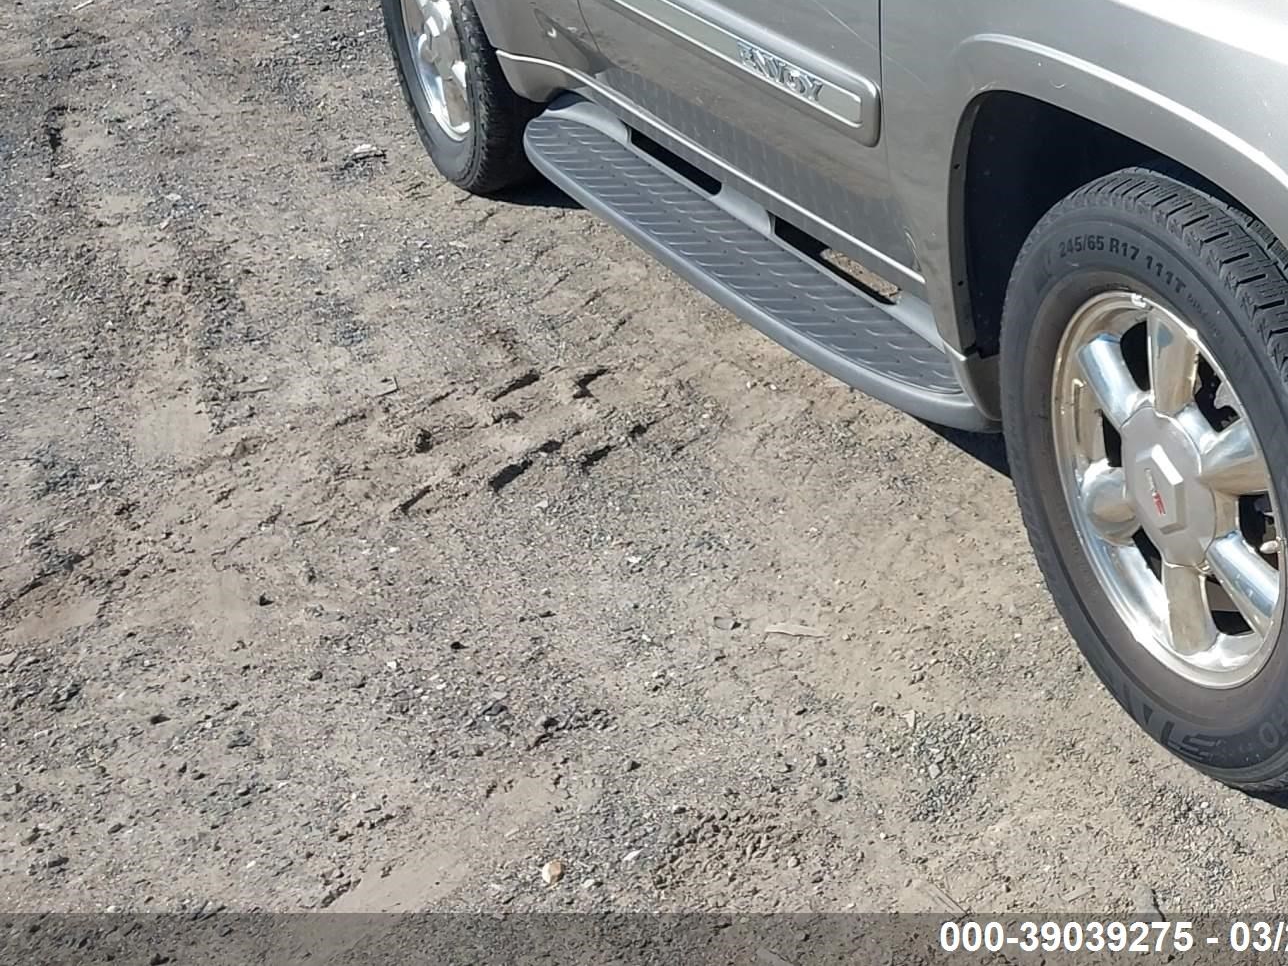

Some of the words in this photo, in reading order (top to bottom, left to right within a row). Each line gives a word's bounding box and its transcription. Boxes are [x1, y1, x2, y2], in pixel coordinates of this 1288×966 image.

[736, 41, 824, 103] ENVOY
[1058, 234, 1105, 259] 245/65
[1109, 237, 1141, 261] R17
[1145, 254, 1187, 294] 111T
